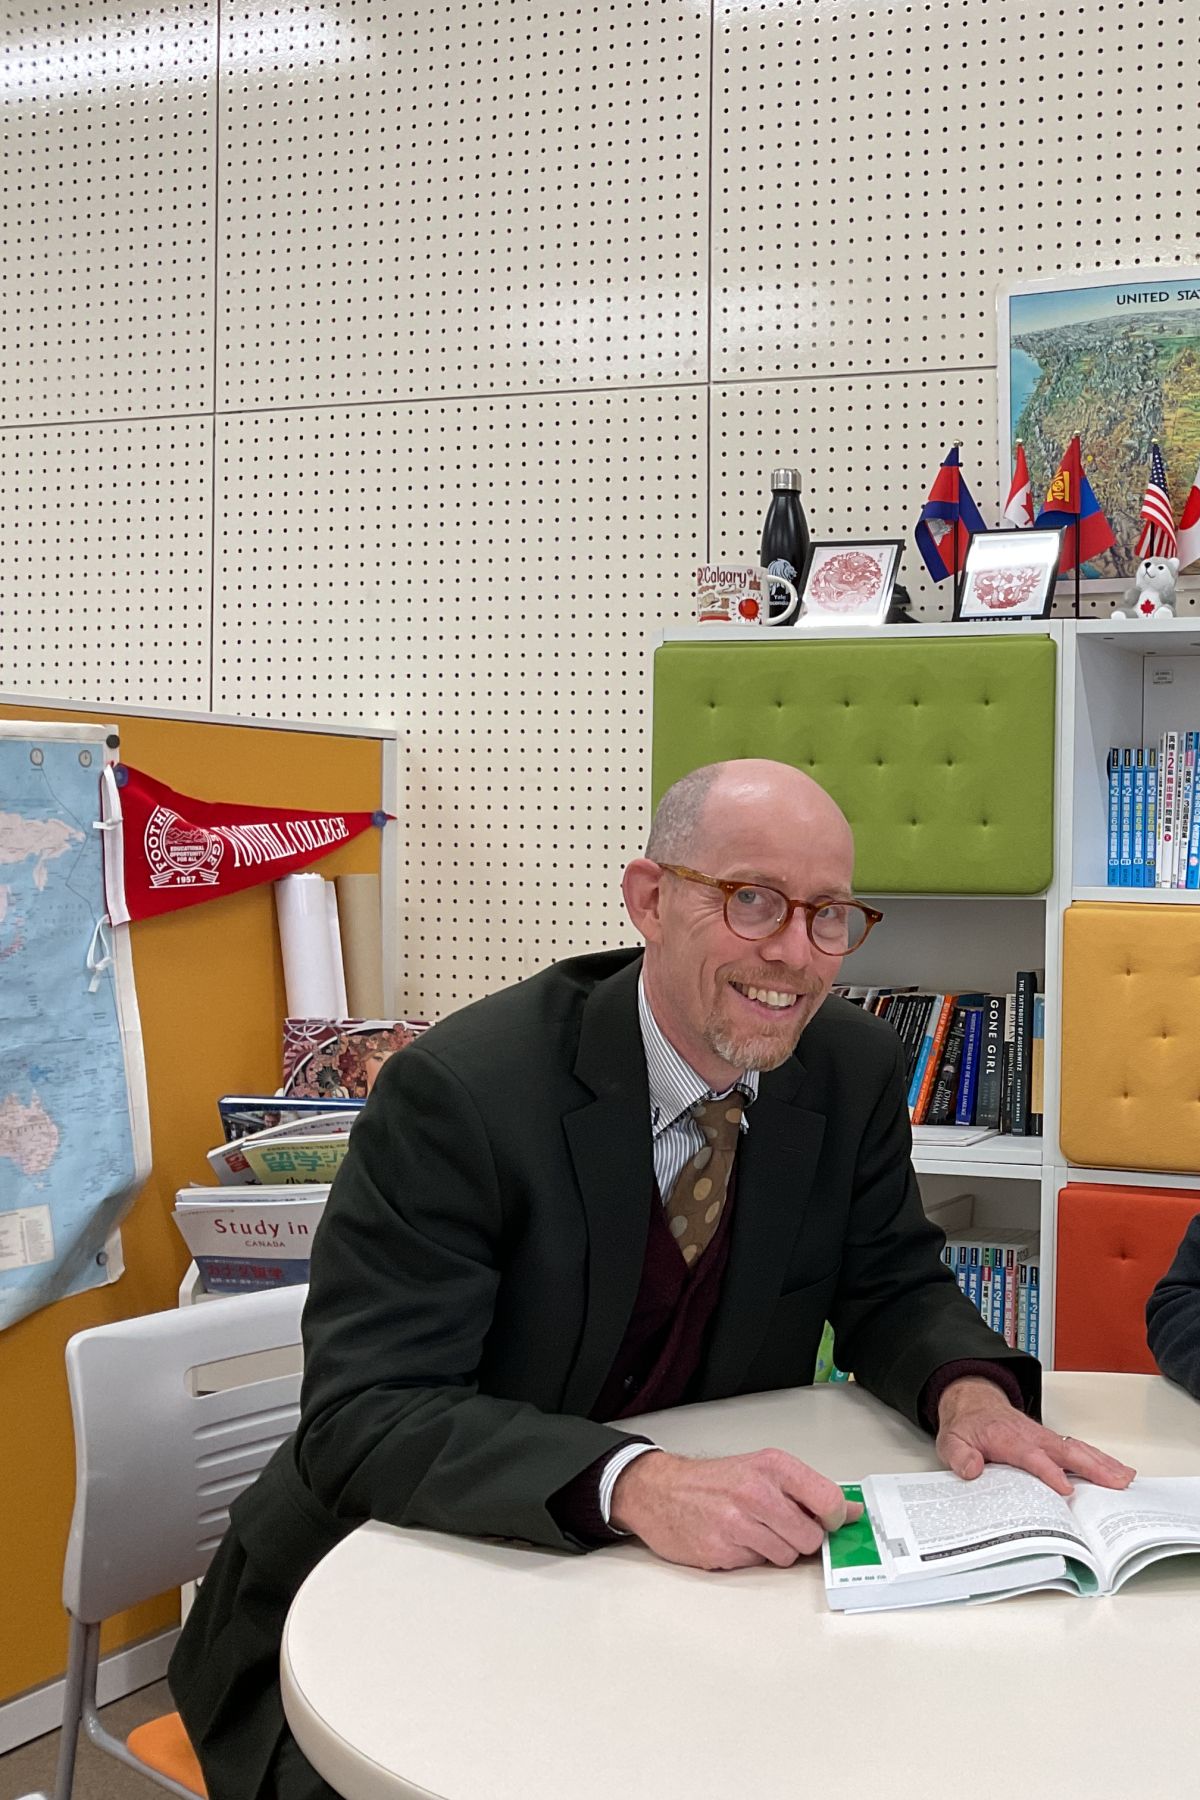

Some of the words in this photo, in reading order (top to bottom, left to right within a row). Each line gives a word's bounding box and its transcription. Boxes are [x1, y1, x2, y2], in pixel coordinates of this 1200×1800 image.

[1117, 292, 1169, 305] UNITED
[285, 817, 349, 853] COLLEGE
[176, 876, 196, 884] 1957
[988, 999, 999, 1039] GONE
[986, 1045, 996, 1074] GIRL
[214, 1219, 279, 1238] Study
[288, 1222, 308, 1235] in
[245, 1240, 285, 1248] CANADA
